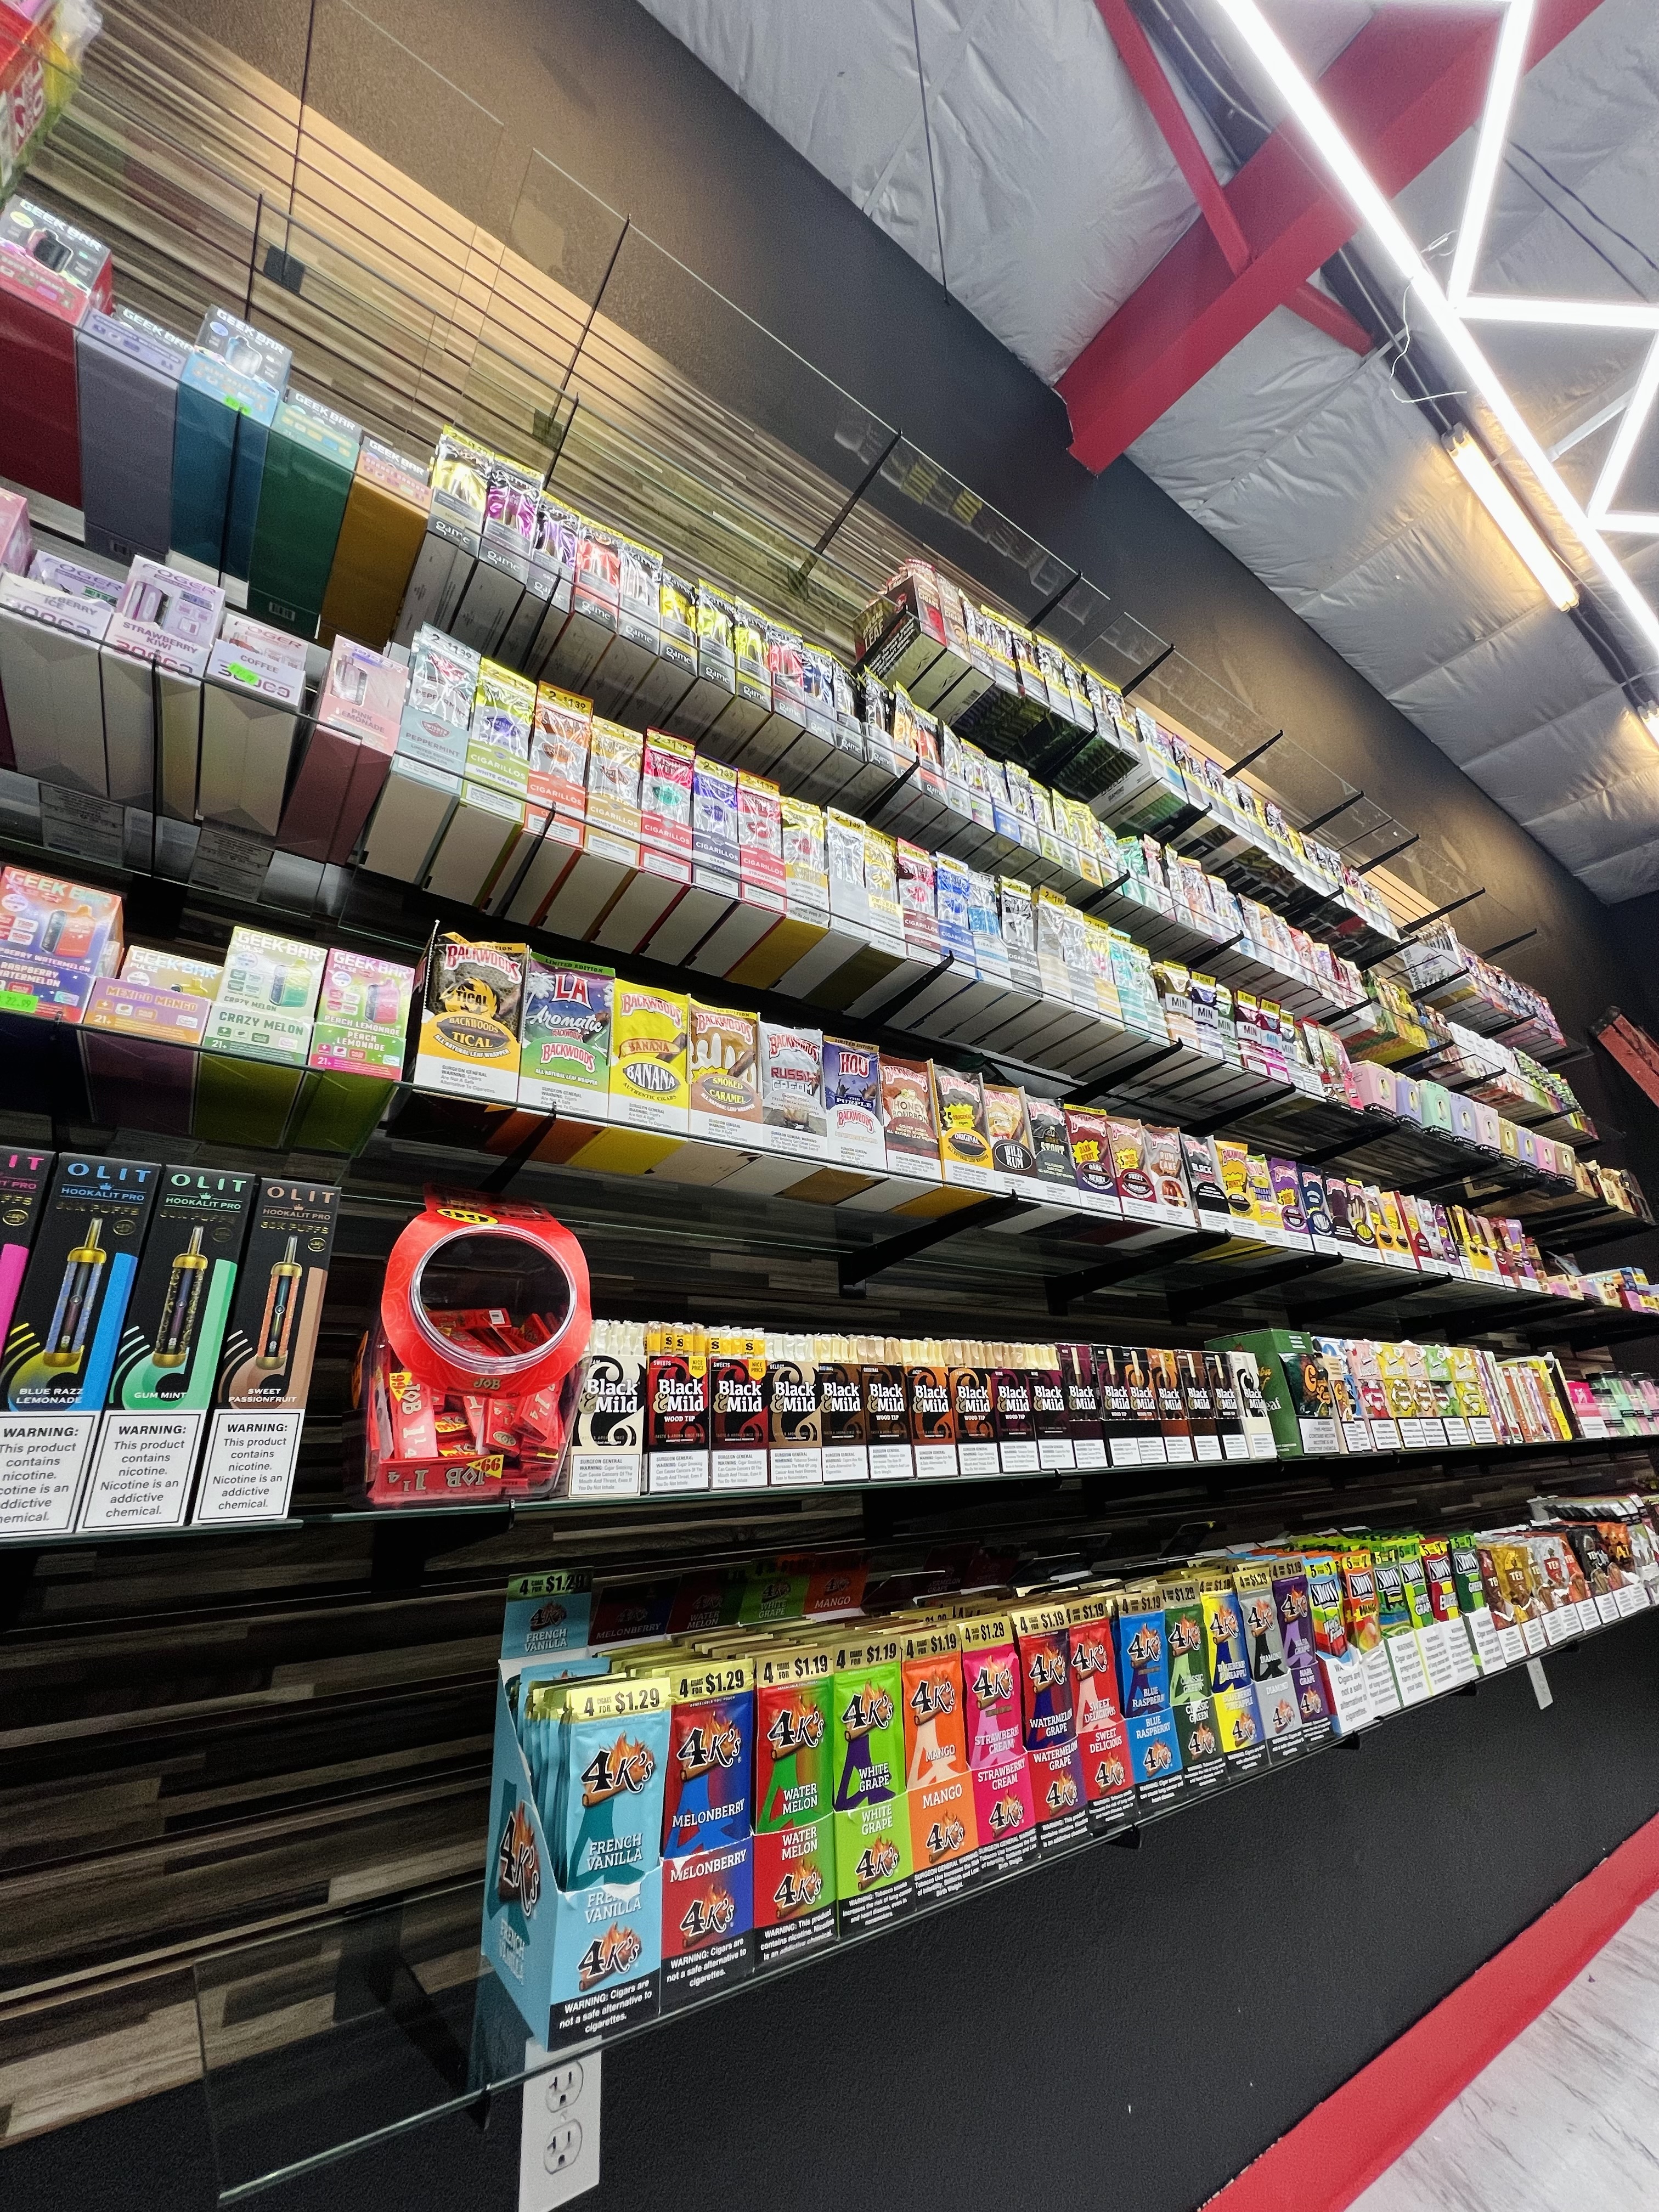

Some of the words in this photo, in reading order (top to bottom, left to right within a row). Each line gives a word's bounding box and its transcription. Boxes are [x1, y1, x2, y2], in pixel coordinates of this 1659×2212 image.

[20, 199, 69, 233] GEEK
[66, 227, 103, 252] BAR
[295, 393, 329, 416] GEEK
[329, 413, 356, 431] BAR
[487, 551, 521, 572] game
[143, 563, 216, 595] FOGER
[582, 601, 611, 620] game
[123, 622, 198, 654] STRAWBERRY
[146, 636, 172, 651] KIWI
[234, 620, 302, 650] FOGER
[865, 619, 883, 651] LEAF
[240, 654, 279, 674] COFFEE
[665, 646, 691, 665] game
[549, 691, 556, 702] 2
[405, 732, 460, 757] PEPPERMINT
[470, 754, 526, 780] CIGARILLOS
[475, 768, 496, 780] WHITE
[496, 775, 518, 788] GRAPE
[530, 784, 583, 806] CIGARILLOS
[590, 806, 639, 828] CIGARILLOS
[591, 818, 612, 829] HONEY
[612, 823, 635, 837] BANANA
[644, 825, 690, 845] CIGARILLOS
[743, 857, 783, 877] CIGARILLOS
[748, 870, 779, 884] STRAWBERRY
[236, 933, 287, 954] GEEK
[286, 945, 323, 962] BAR
[1, 961, 59, 978] RASPBERRY
[131, 949, 179, 971] GEEK
[180, 960, 223, 979] BAR
[333, 951, 377, 970] GEEK
[377, 962, 409, 979] BAR
[444, 944, 522, 984] BACKWOODS
[545, 960, 572, 968] LIMITED
[574, 964, 603, 973] EDITION
[107, 985, 152, 1003] MEXICO
[155, 995, 198, 1013] MANGO
[456, 991, 487, 1006] TICAL
[552, 973, 592, 1011] LA
[526, 1006, 603, 1032] Aromatic
[621, 993, 683, 1029] BACKWOODS
[219, 1012, 261, 1027] CRAZY
[263, 1020, 304, 1036] MELON
[324, 1015, 353, 1026] PEACH
[355, 1023, 400, 1036] LEMONADE
[449, 1018, 499, 1033] BACKWOODS
[696, 1012, 753, 1045] BACKWOODS
[336, 1037, 385, 1052] LEMONADE
[347, 1031, 377, 1042] PEACH
[452, 1031, 493, 1048] TICAL
[630, 1040, 670, 1052] BANANA
[541, 1043, 596, 1073] BACKWOODS
[769, 1034, 820, 1065] BACKWOODS
[839, 1052, 870, 1078] HOU
[627, 1063, 676, 1091] BANANA
[712, 1077, 743, 1090] SMOKED
[623, 1082, 656, 1101] AUTHENTIC
[709, 1089, 746, 1104] CARAMEL
[836, 1097, 873, 1109] PURPLE
[893, 1101, 927, 1114] HONEY
[837, 1109, 874, 1134] BACKWOODS
[893, 1110, 928, 1125] BOURBON
[954, 1133, 980, 1145] ORIGINAL
[1005, 1146, 1023, 1158] WILD
[1006, 1156, 1024, 1169] RUM
[67, 1163, 151, 1183] OLIT
[171, 1173, 246, 1192] OLIT
[61, 1187, 120, 1199] HOOKALIT
[122, 1193, 145, 1201] PRO
[166, 1197, 218, 1208] HOOKALIT
[267, 1186, 335, 1204] OLIT
[263, 1208, 311, 1218] HOOKALIT
[473, 1378, 501, 1390] JOB
[586, 1379, 638, 1395] Black
[658, 1379, 703, 1395] Black
[718, 1380, 762, 1396] Black
[957, 1386, 989, 1399] Black
[578, 1392, 599, 1414] &
[594, 1396, 637, 1413] Mild
[653, 1392, 670, 1414] &
[667, 1396, 704, 1412] Mild
[726, 1397, 762, 1412] Mild
[965, 1400, 990, 1413] Mild
[119, 1425, 187, 1435] WARNING:
[227, 1424, 288, 1432] WARNING:
[114, 1441, 137, 1450] This
[140, 1440, 184, 1452] product
[224, 1438, 244, 1447] This
[247, 1437, 286, 1448] product
[121, 1454, 171, 1463] contains
[231, 1449, 274, 1459] contains
[119, 1467, 168, 1477] nicotine.
[229, 1462, 272, 1471] nicotine.
[100, 1481, 149, 1491] Nicotine
[153, 1480, 161, 1489] is
[213, 1475, 256, 1485] Nicotine
[259, 1475, 267, 1483] is
[110, 1493, 163, 1504] addictive
[222, 1487, 269, 1497] addictive
[106, 1505, 162, 1518] chemical.
[218, 1499, 268, 1510] chemical.
[527, 1628, 567, 1643] FRENCH
[524, 1640, 567, 1652] VANILLA
[867, 1643, 896, 1664] $1.19
[795, 1655, 828, 1678] $1.19
[706, 1669, 744, 1695] $1.29
[584, 1697, 594, 1717] 4
[615, 1688, 659, 1714] $1.29
[1136, 1722, 1171, 1739] RASPBERRY
[1146, 1716, 1162, 1728] BLUE
[1096, 1728, 1117, 1742] SWEET
[676, 1727, 741, 1768] 4K's
[1033, 1740, 1078, 1763] WATERMELON
[1090, 1737, 1122, 1754] DELICIOUS
[581, 1749, 653, 1794] 4K's
[859, 1762, 889, 1780] WHITE
[978, 1757, 1026, 1783] STRAWBERRY
[1049, 1756, 1071, 1771] GRAPE
[859, 1775, 890, 1793] GRAPE
[992, 1773, 1018, 1790] CREAM
[783, 1782, 817, 1802] WATER
[923, 1784, 963, 1809] MANGO
[672, 1798, 745, 1827] MELONBERRY
[782, 1795, 818, 1815] MELON
[590, 1833, 642, 1856] FRENCH
[587, 1848, 642, 1871] VANILLA
[670, 1849, 747, 1882] MELONBERRY
[670, 1951, 709, 1969] WARNING:
[710, 1943, 732, 1957] Cigars
[733, 1938, 744, 1946] are
